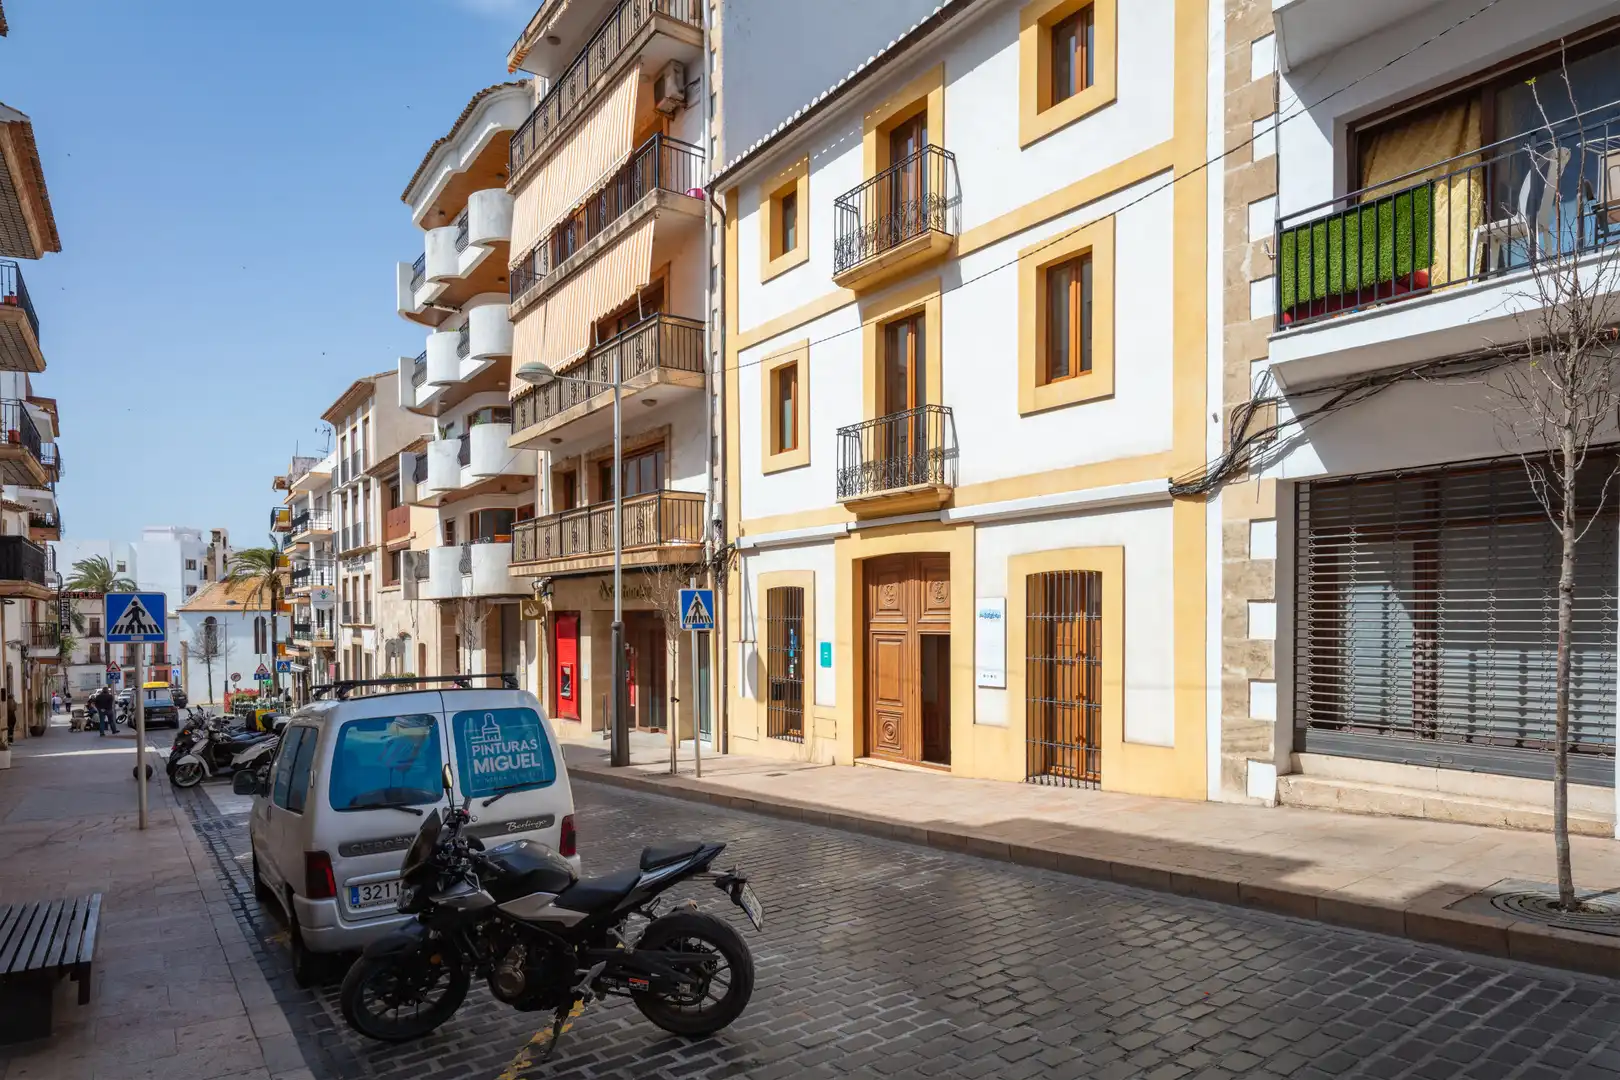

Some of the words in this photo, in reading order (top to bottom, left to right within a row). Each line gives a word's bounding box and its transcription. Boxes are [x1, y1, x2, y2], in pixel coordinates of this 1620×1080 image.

[472, 740, 538, 756] PINTURAS
[473, 752, 540, 774] MIGUEL
[507, 819, 547, 831] Berlingo
[363, 882, 400, 901] 3211
